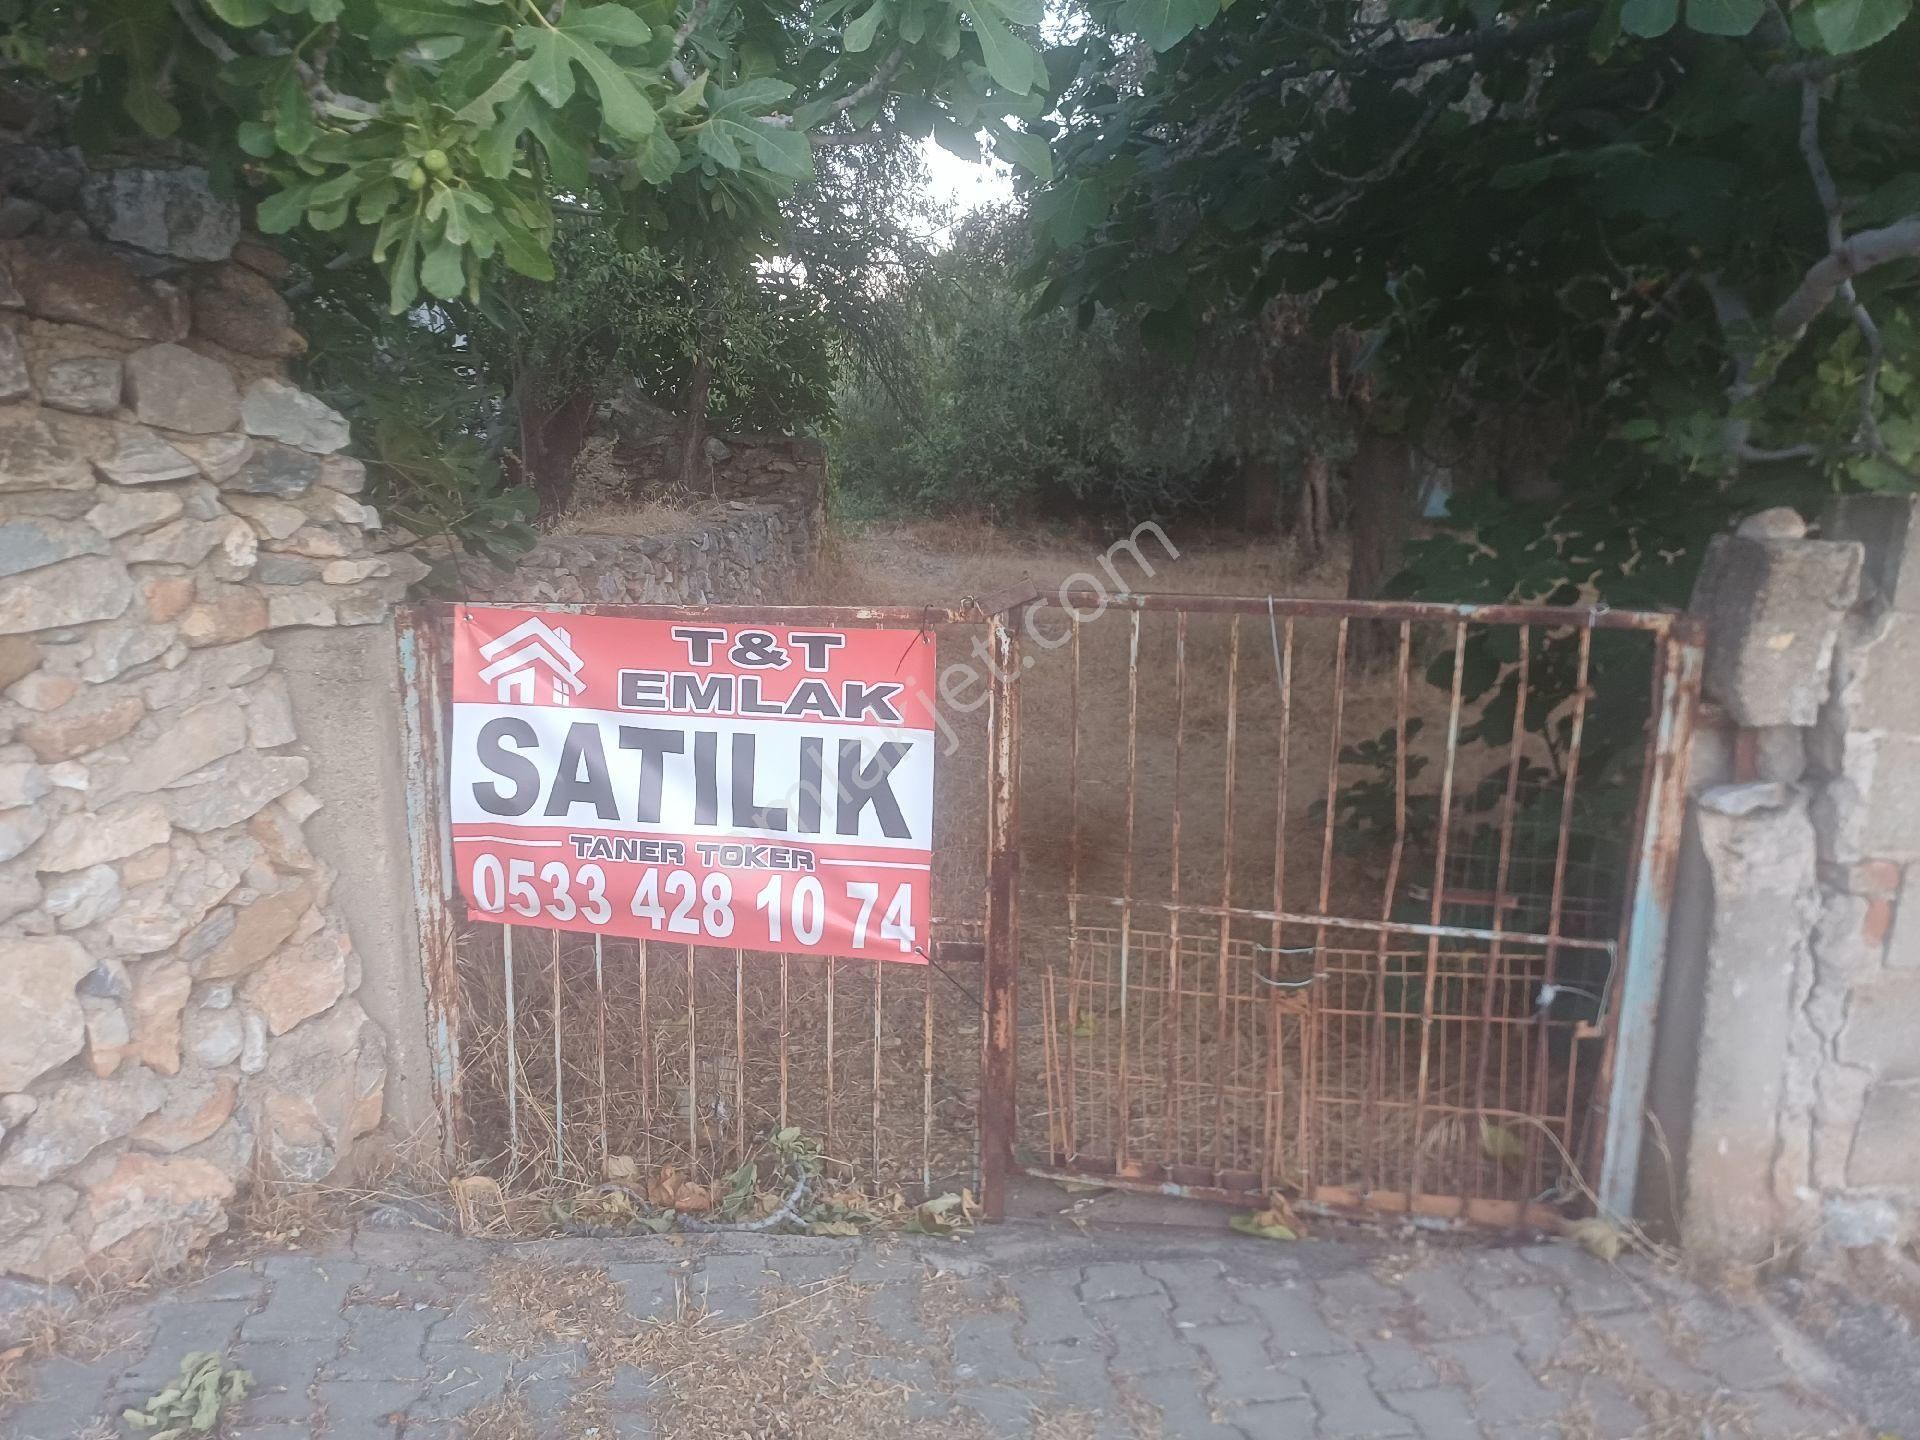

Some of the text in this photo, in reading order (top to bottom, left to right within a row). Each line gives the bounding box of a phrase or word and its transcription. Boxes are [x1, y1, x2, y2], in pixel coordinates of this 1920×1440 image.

[671, 625, 846, 673] T&T
[617, 669, 905, 723] EMLAK
[471, 717, 915, 839] SATILIK
[569, 834, 816, 873] TANER TOKER
[472, 853, 917, 953] 0533 428 10 74
